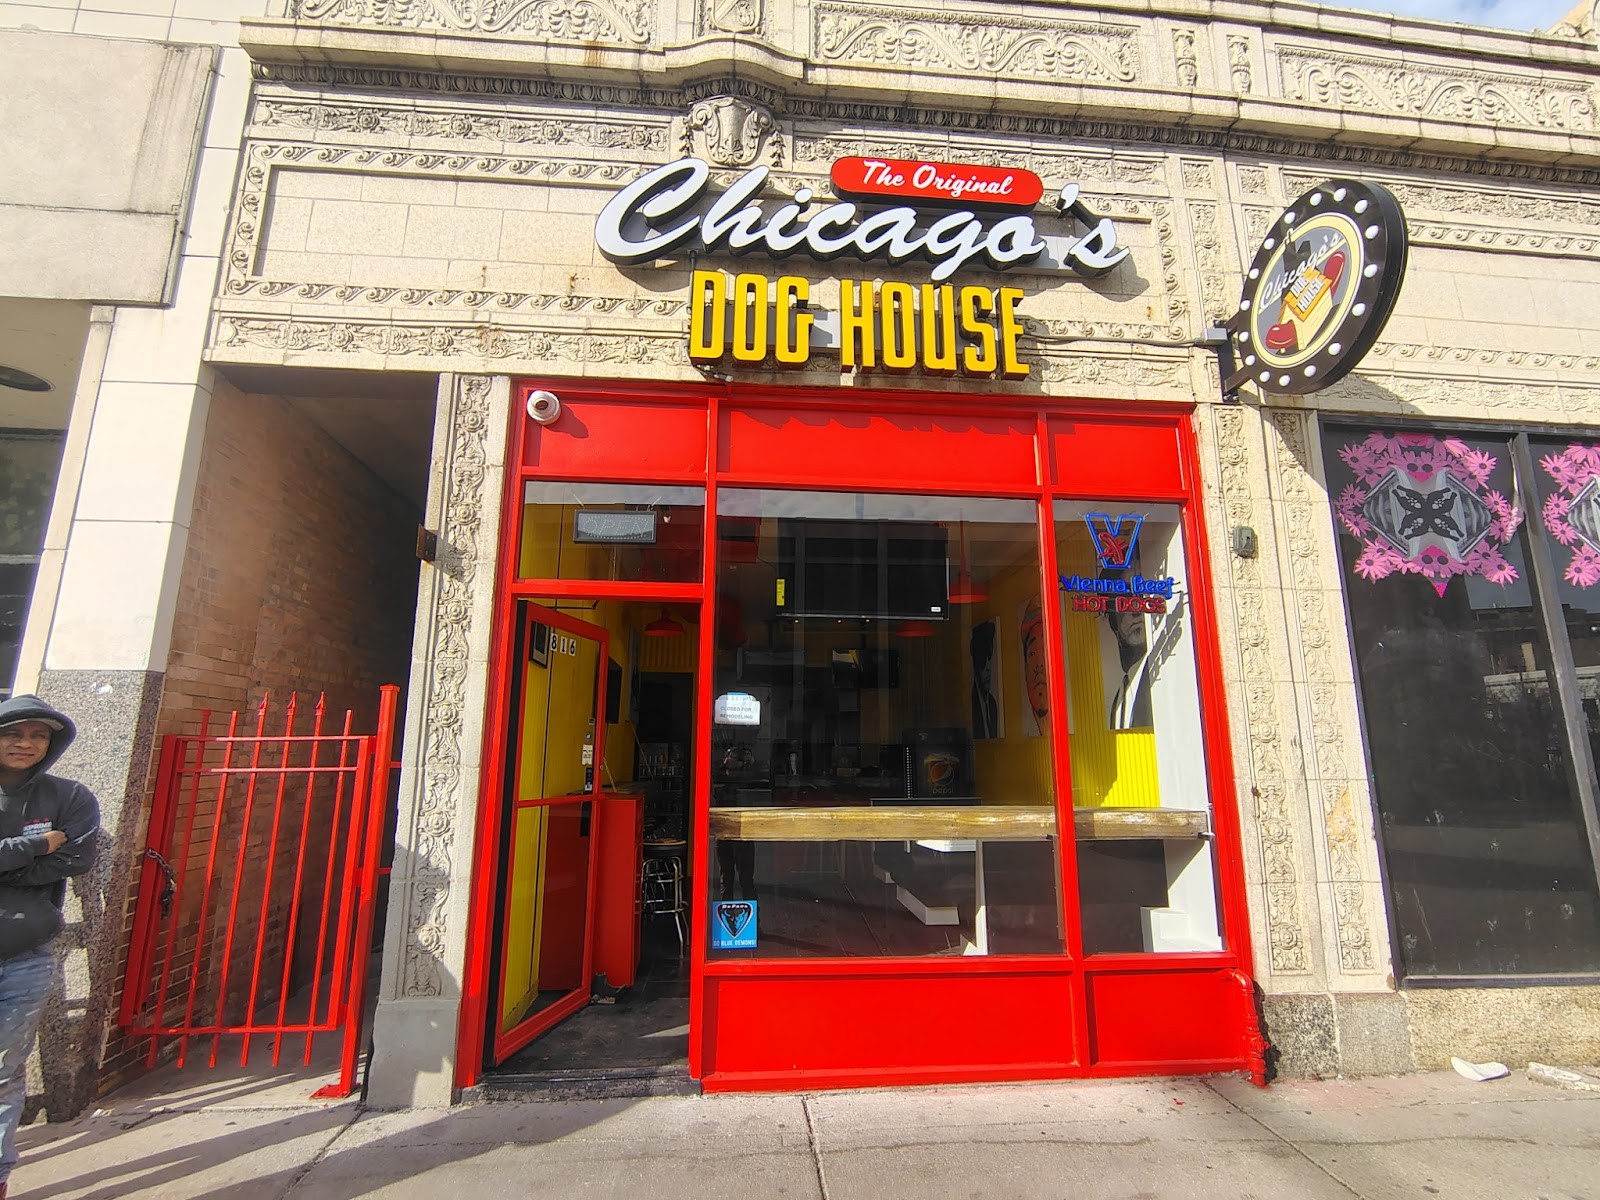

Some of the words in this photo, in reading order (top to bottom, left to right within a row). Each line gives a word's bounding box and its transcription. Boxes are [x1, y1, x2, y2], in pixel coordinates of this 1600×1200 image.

[863, 160, 905, 187] The
[912, 164, 1014, 198] Original
[595, 158, 1129, 281] Chicago's
[1260, 232, 1342, 308] Chicago's
[1290, 276, 1309, 299] DOG
[1296, 277, 1326, 314] HOUSE
[690, 270, 815, 365] DOG
[840, 279, 1031, 376] HOUSE
[583, 517, 648, 537] OPEN
[1060, 575, 1127, 593] Vienna
[1131, 575, 1174, 599] Beef
[1073, 595, 1109, 612] HOT
[1116, 595, 1168, 614] DOGS
[550, 633, 576, 656] 816
